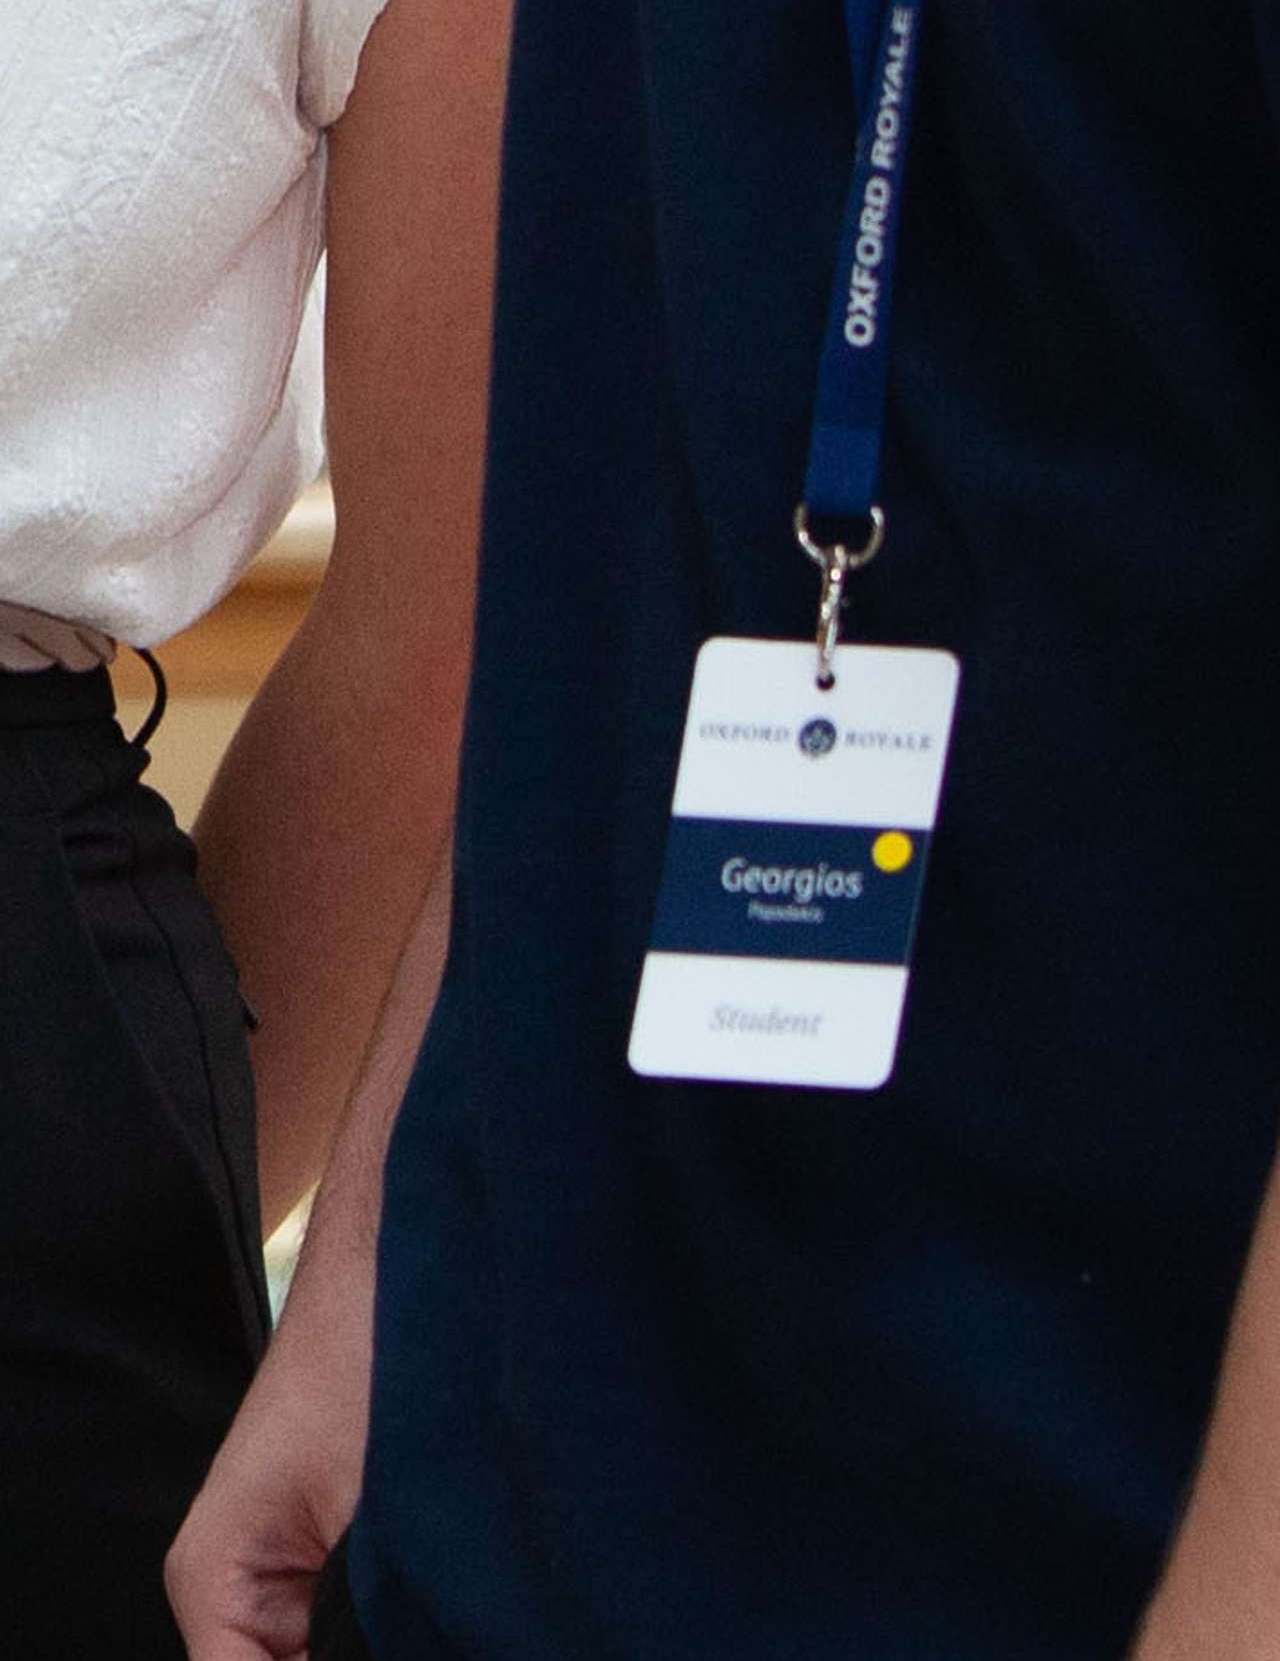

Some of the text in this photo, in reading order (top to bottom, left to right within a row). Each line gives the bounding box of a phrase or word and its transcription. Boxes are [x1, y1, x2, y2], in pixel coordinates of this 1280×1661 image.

[843, 5, 915, 348] OXFORD ROYALE
[698, 722, 932, 750] OXFORD ROYALE
[721, 856, 864, 904] Georgios
[708, 1002, 825, 1037] Student
